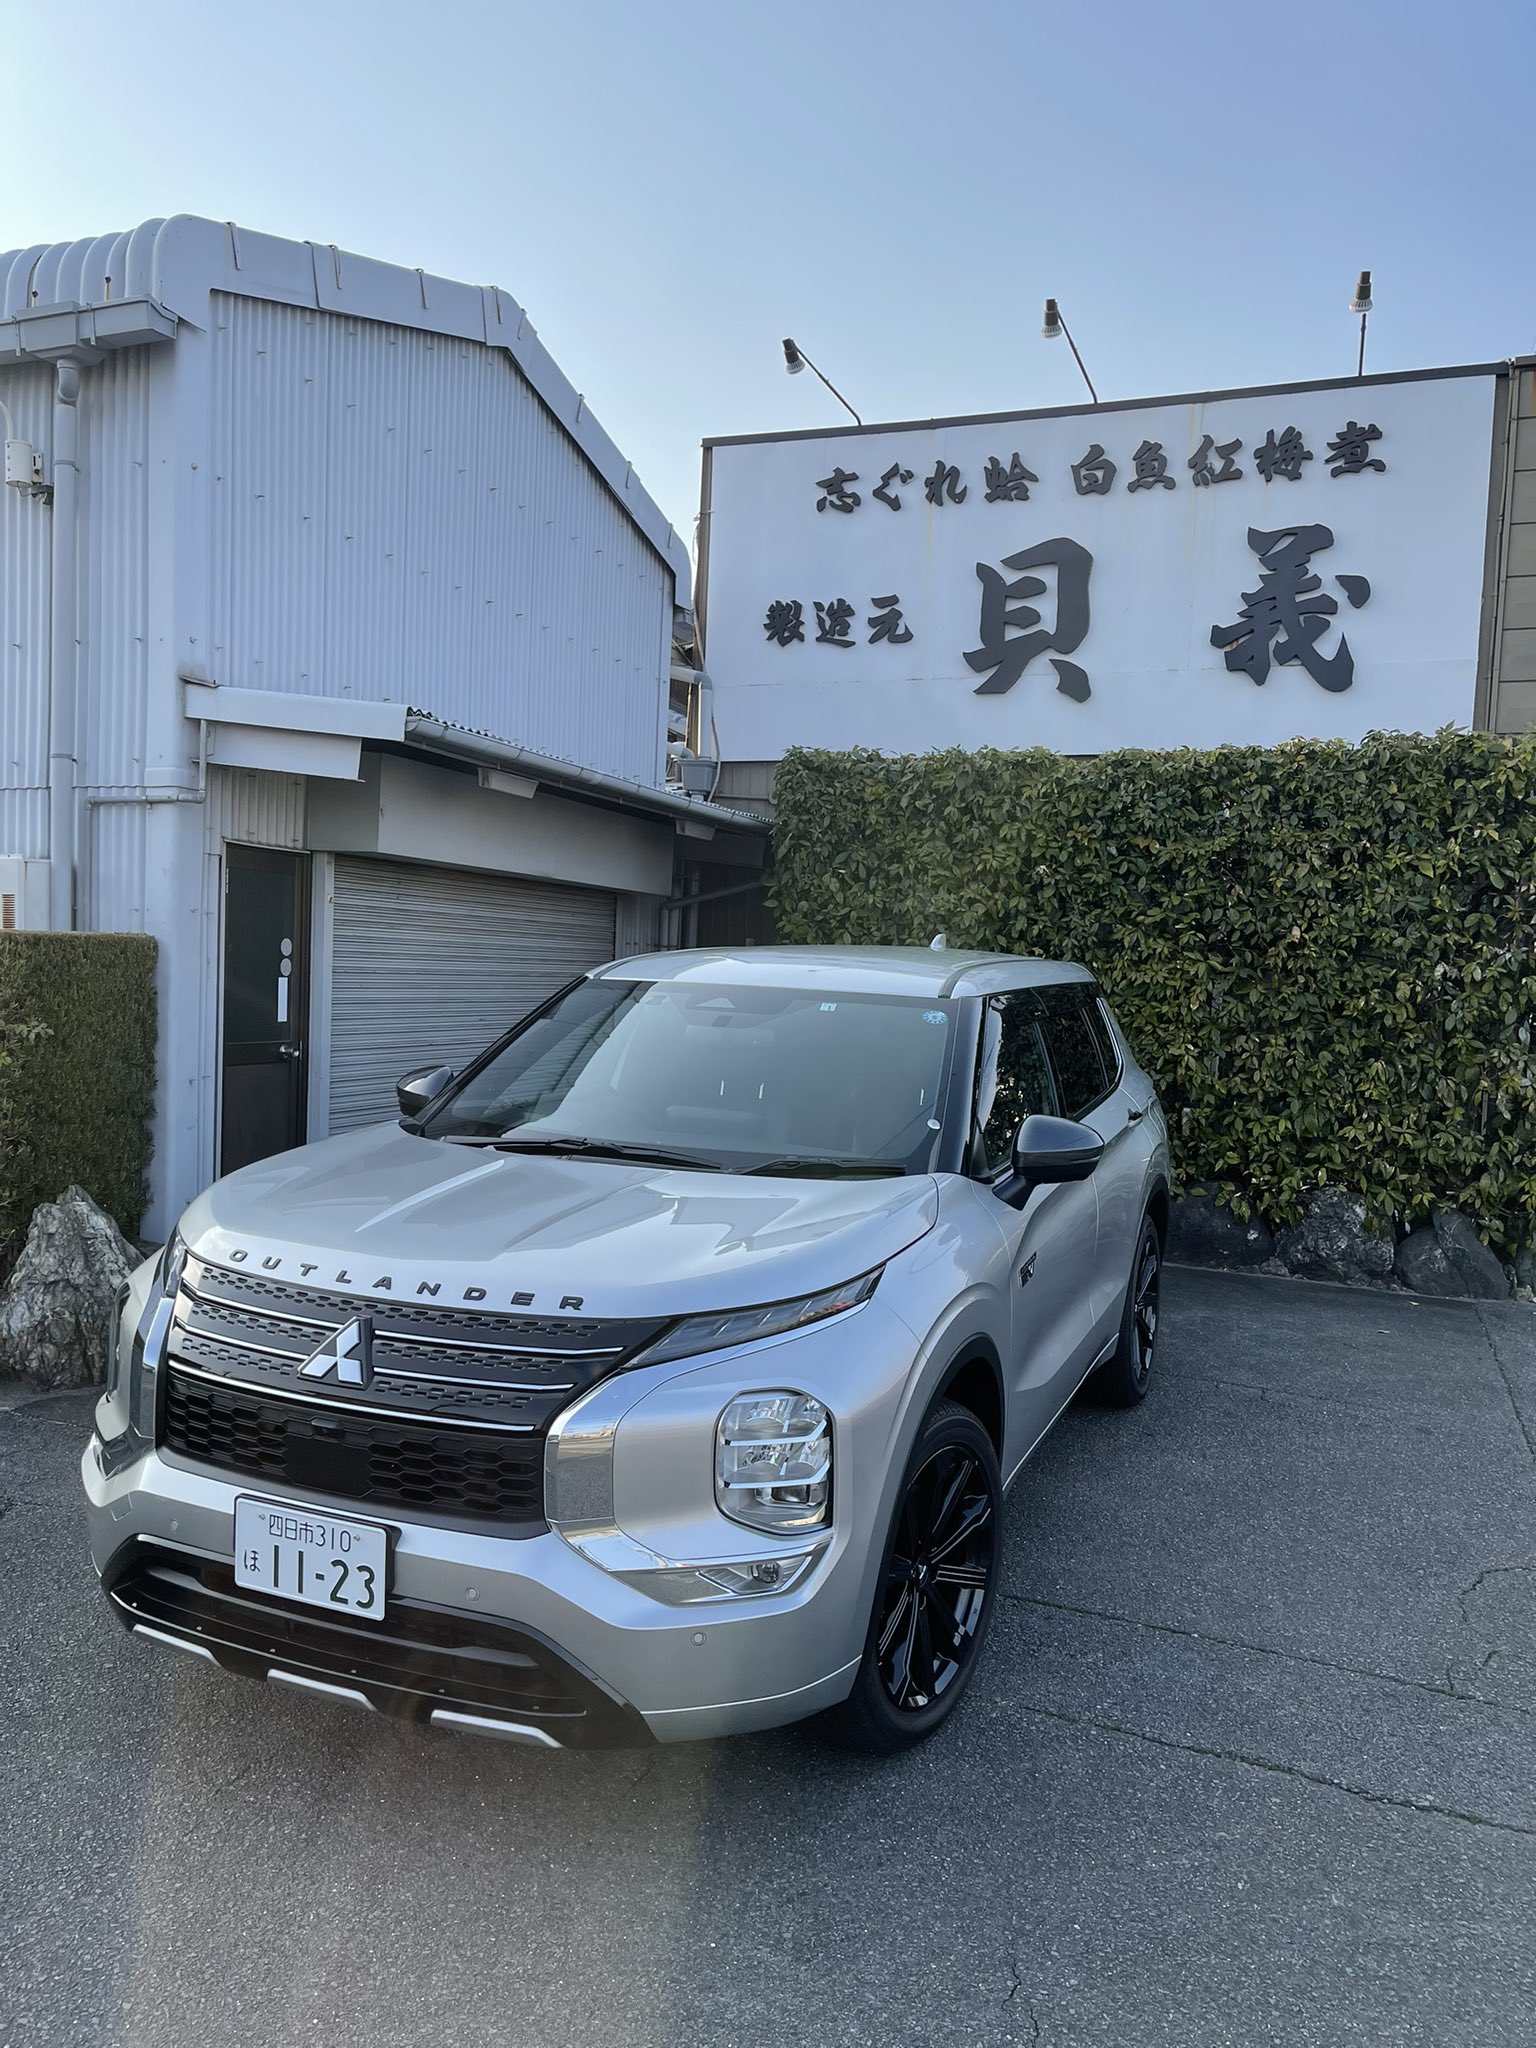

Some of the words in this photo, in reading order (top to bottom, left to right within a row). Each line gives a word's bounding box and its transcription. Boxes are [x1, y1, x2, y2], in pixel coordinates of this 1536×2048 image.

[815, 451, 1039, 514] 志ぐれ蛤
[1071, 420, 1387, 496] 白魚紅梅煮
[763, 594, 915, 648] 製造元
[228, 1248, 585, 1312] OUTLANDER
[272, 1543, 376, 1610] 11-23
